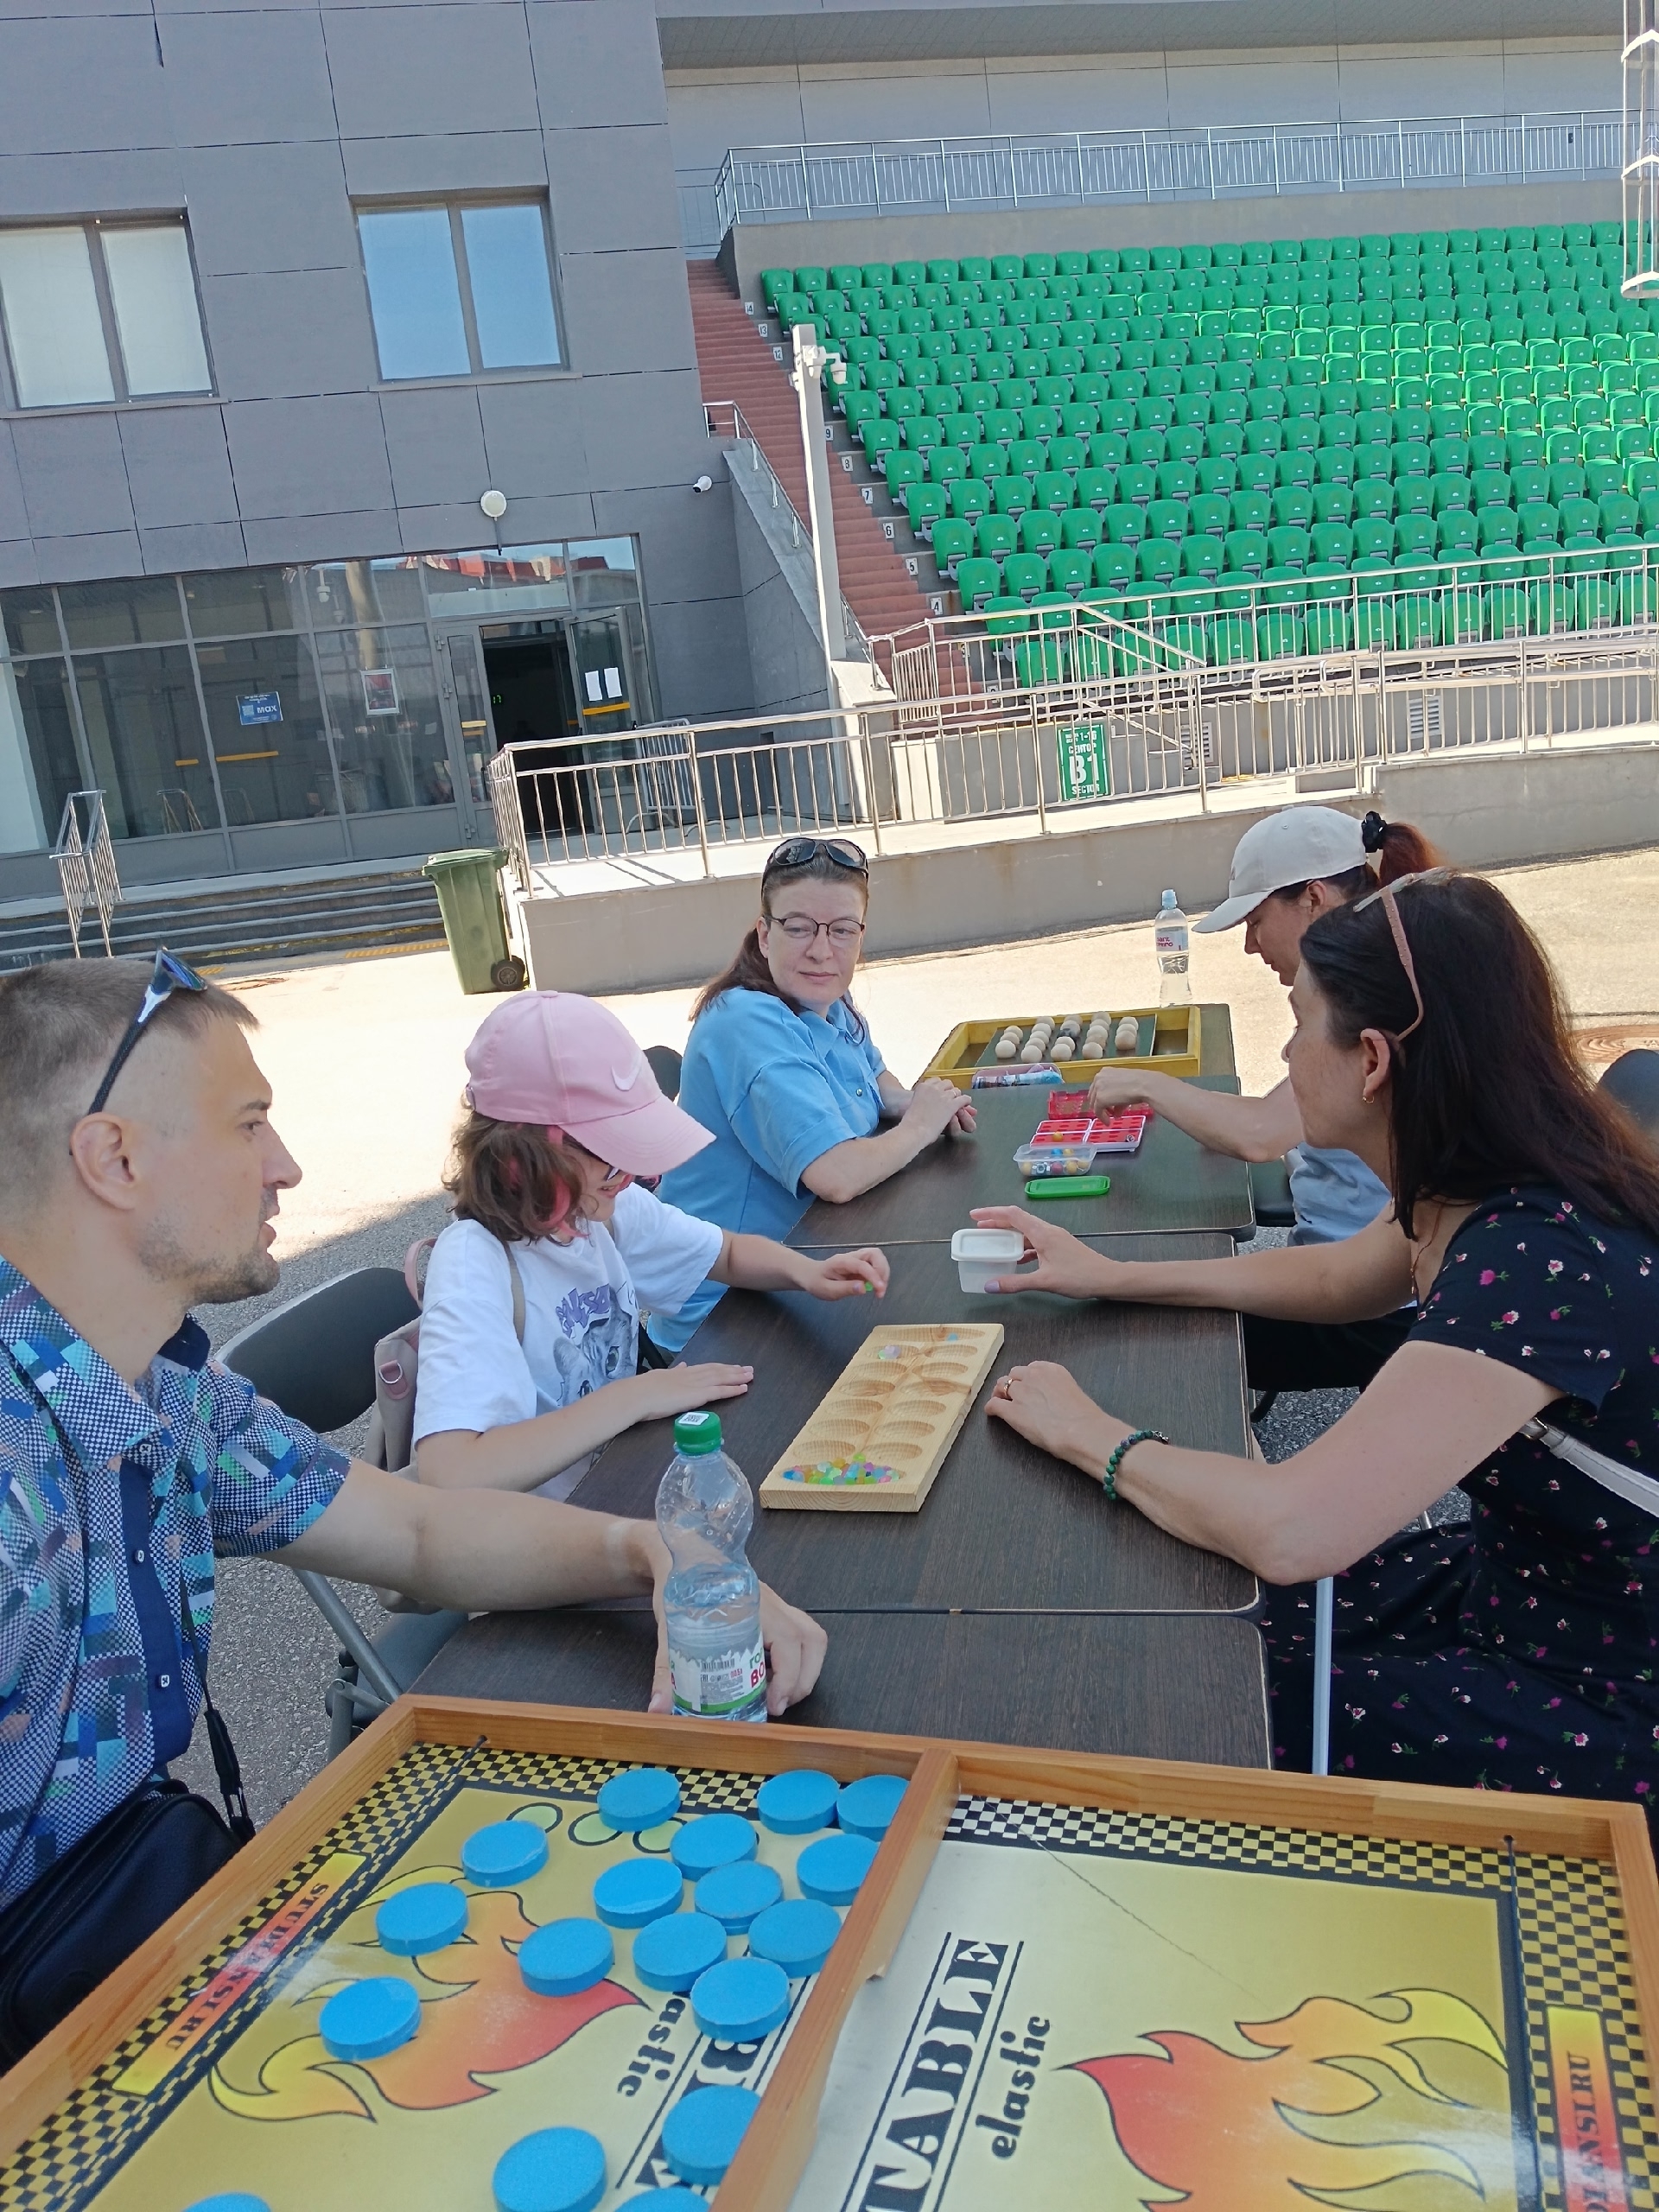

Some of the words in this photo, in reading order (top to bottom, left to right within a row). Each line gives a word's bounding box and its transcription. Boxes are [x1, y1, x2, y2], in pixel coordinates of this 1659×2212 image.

[886, 525, 892, 536] 6
[934, 601, 939, 612] 4
[1071, 784, 1100, 795] SECTOR
[616, 1991, 691, 2098] astic
[858, 1939, 1009, 2212] TABLE
[976, 2016, 1051, 2160] elastic
